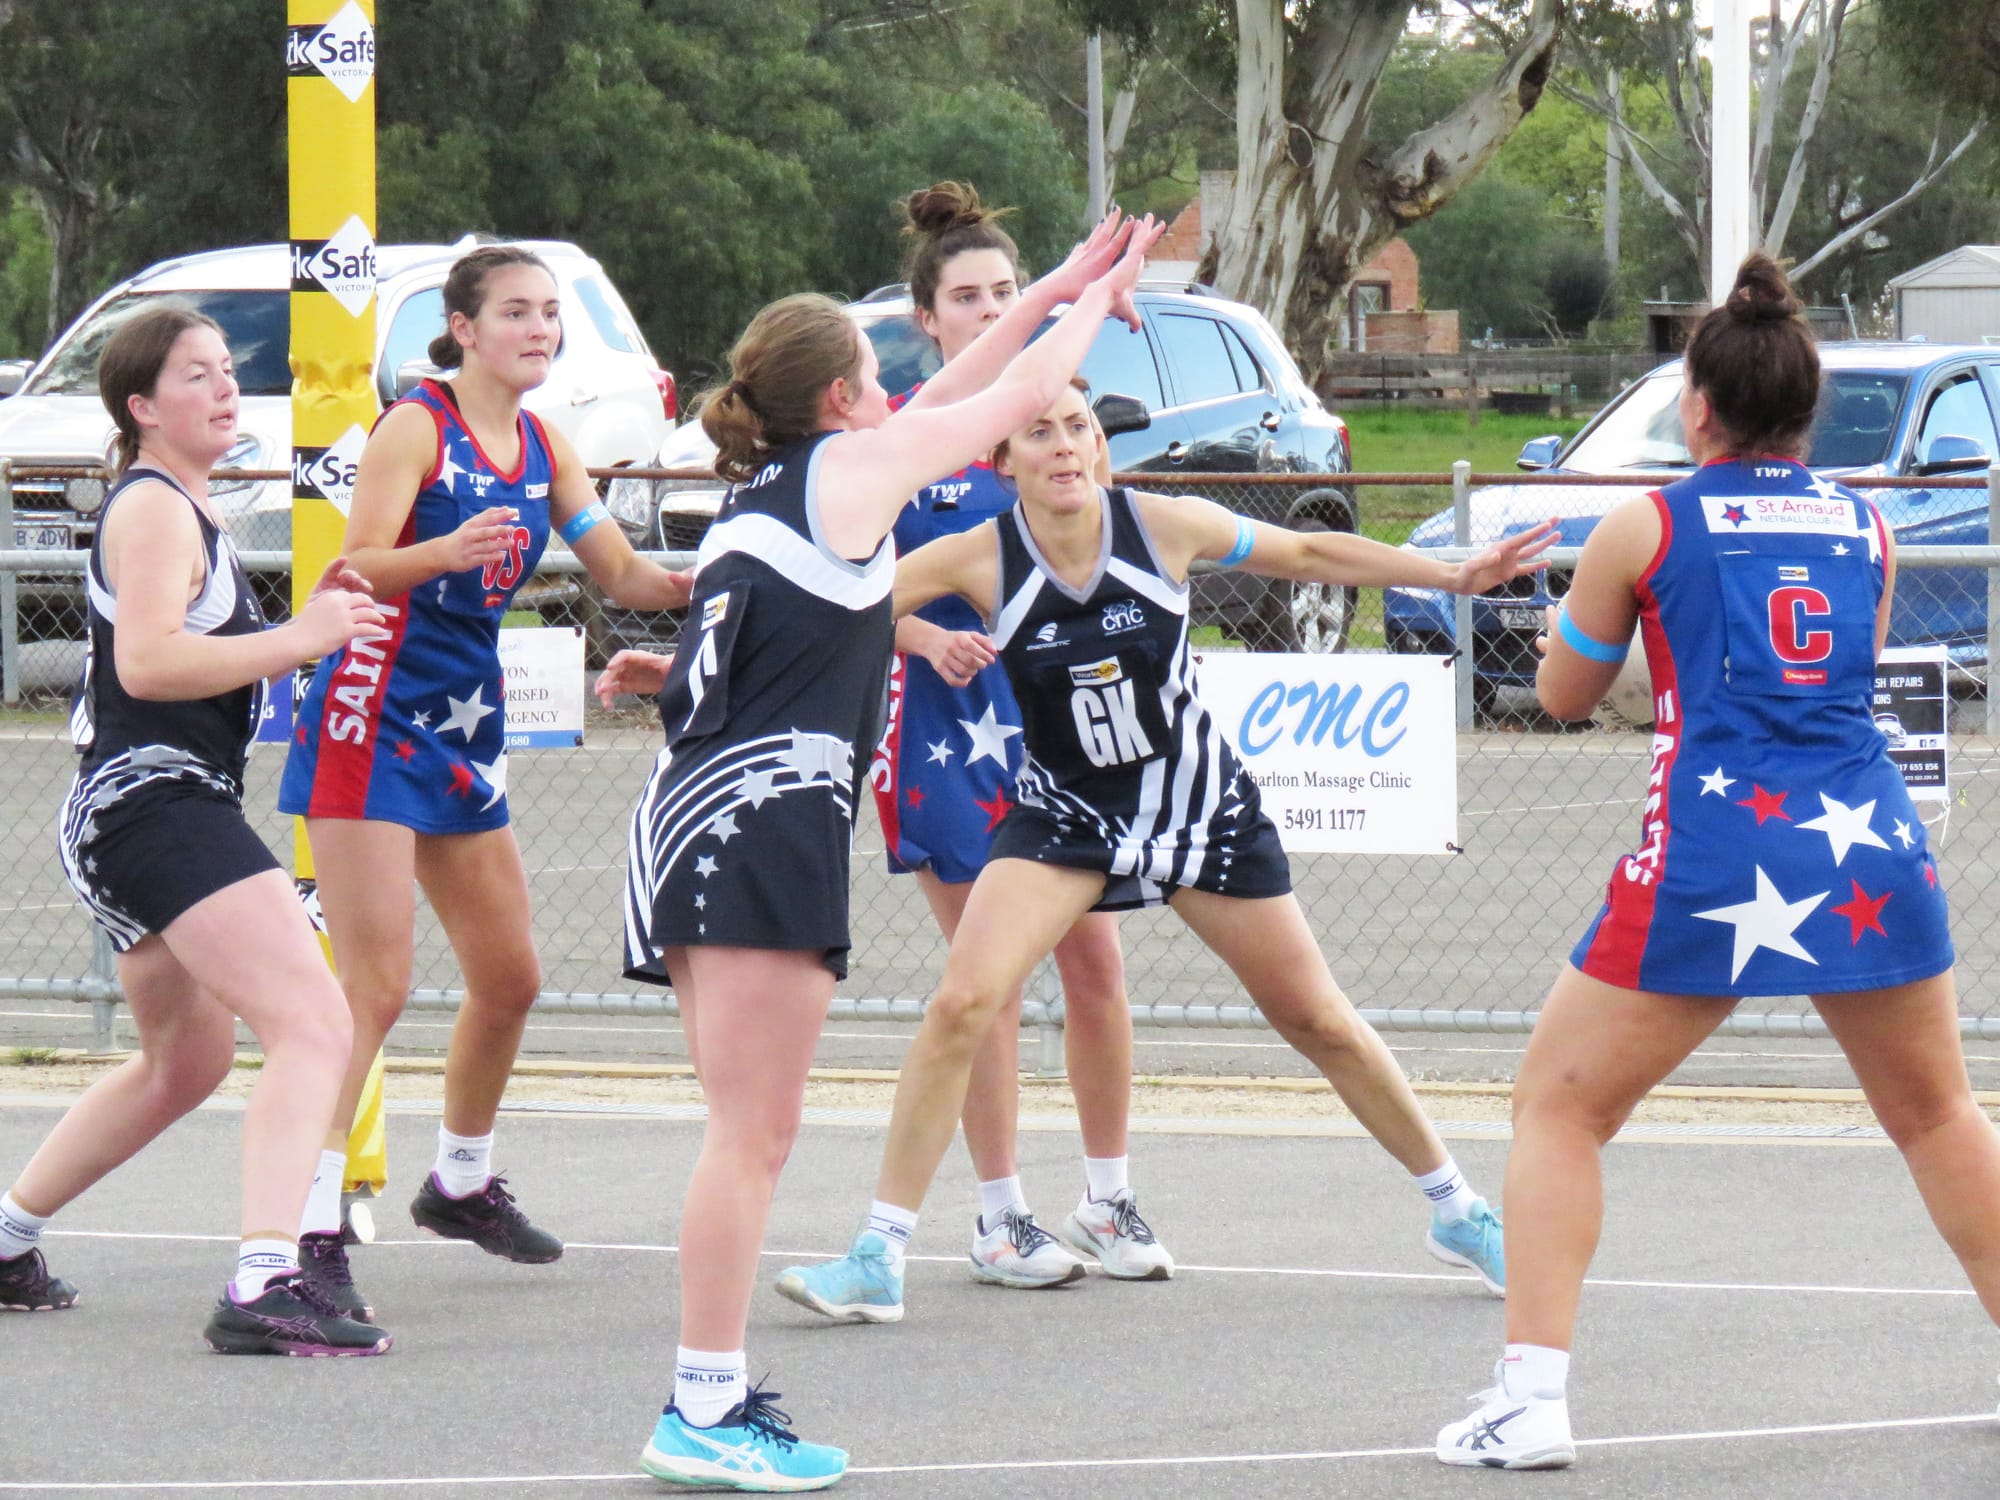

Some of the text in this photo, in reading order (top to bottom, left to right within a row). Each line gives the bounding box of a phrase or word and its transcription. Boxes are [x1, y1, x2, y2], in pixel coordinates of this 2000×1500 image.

[1754, 467, 1793, 478] TWP
[467, 473, 496, 487] TWP
[334, 492, 353, 500] VIC
[929, 482, 972, 499] TWP
[1756, 499, 1845, 516] St Arnaud
[1760, 515, 1804, 524] NETBALL
[1806, 516, 1831, 525] CLUB
[1768, 585, 1833, 664] C
[1889, 676, 1924, 688] REPAIRS
[1873, 694, 1892, 705] IONS
[505, 710, 559, 724] AGENCY
[1071, 678, 1154, 768] GK
[1239, 680, 1411, 758] CMC
[506, 735, 530, 746] 1680
[1249, 771, 1412, 793] harlton Massage Clinic
[1284, 808, 1366, 830] 5491 1177
